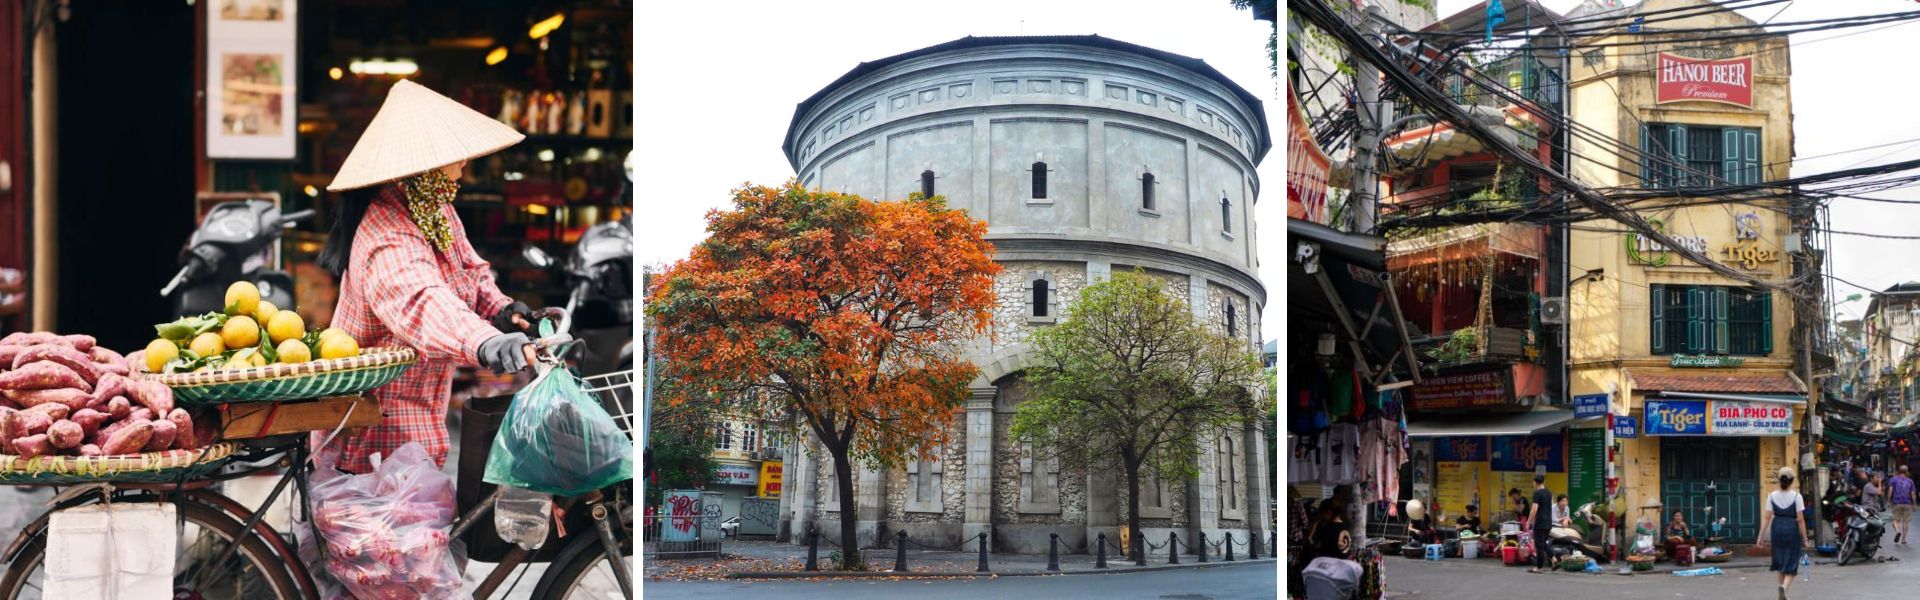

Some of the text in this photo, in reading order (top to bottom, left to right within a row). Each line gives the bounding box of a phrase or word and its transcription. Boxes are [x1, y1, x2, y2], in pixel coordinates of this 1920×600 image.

[1662, 58, 1747, 88] HANOI BEER
[1681, 84, 1728, 99] Premium
[1725, 240, 1778, 270] Tiger
[1464, 373, 1489, 383] COFFEE
[1659, 408, 1704, 432] Tiger
[1719, 407, 1740, 418] BIA
[1510, 439, 1551, 469] Tiger
